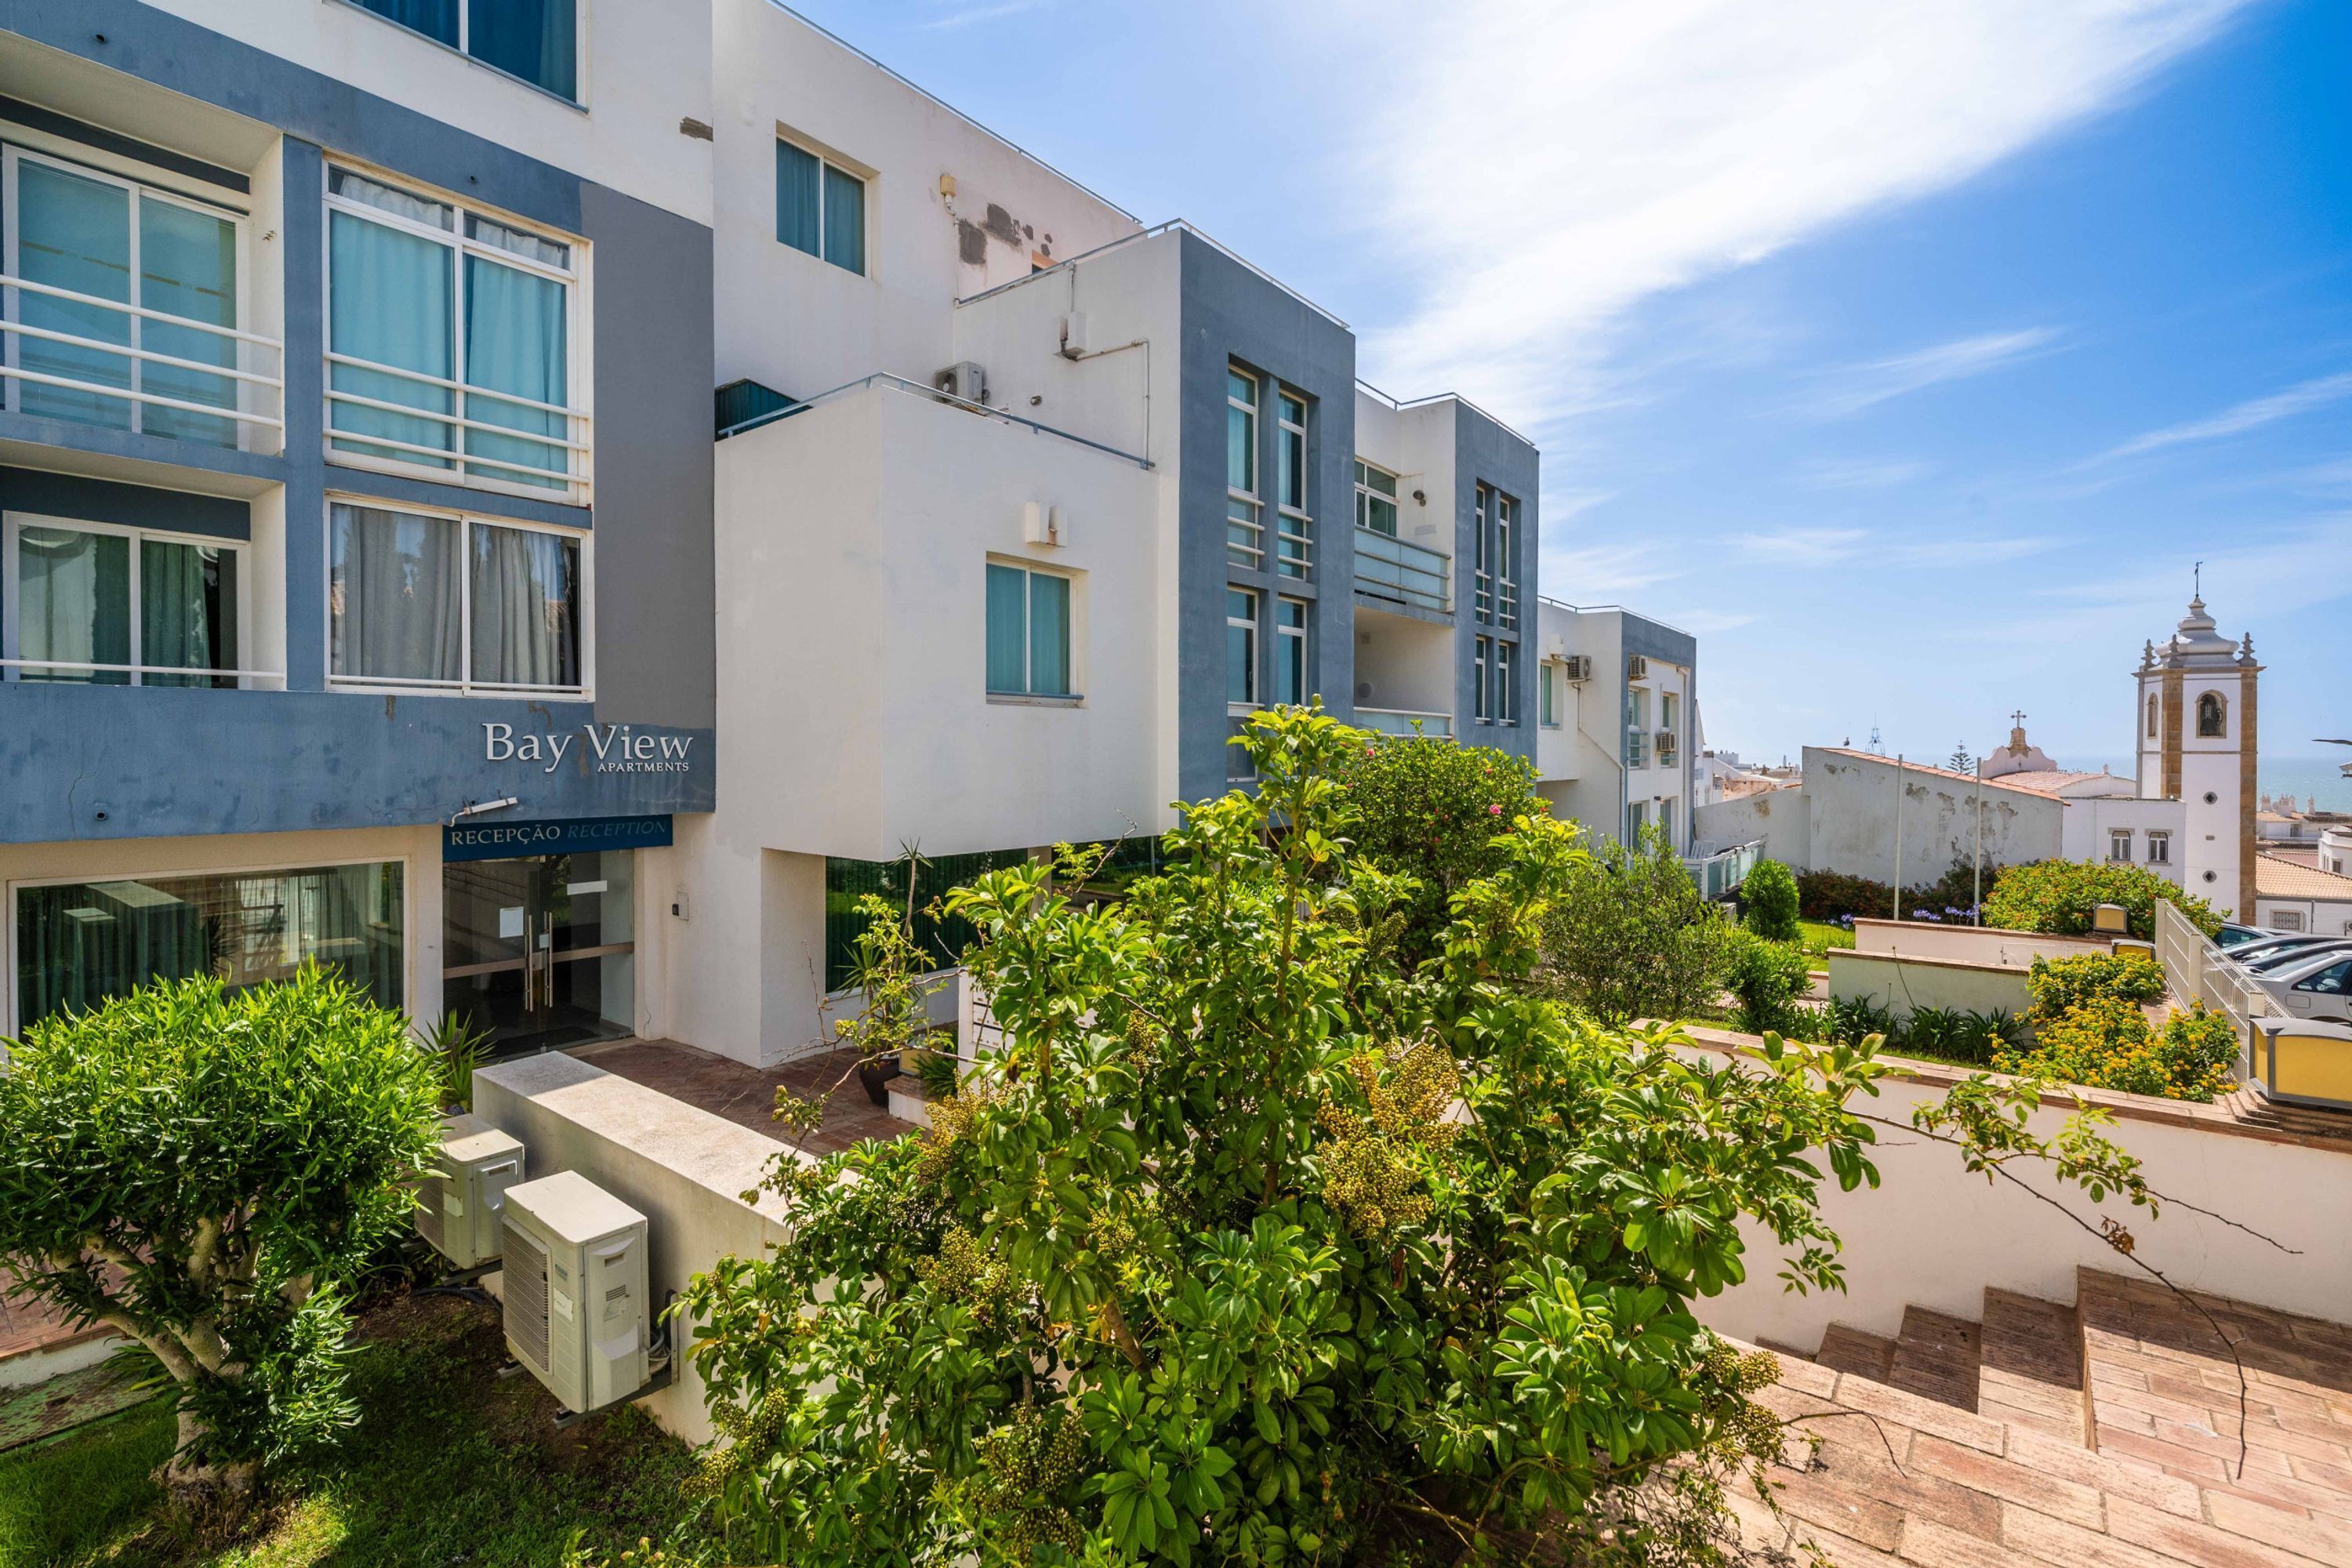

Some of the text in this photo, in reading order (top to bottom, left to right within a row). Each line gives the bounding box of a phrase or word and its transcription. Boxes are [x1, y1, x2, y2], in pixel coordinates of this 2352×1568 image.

[481, 723, 693, 773] Bay View
[597, 762, 689, 772] APARTMENTS
[452, 821, 666, 845] RECEPÇÃO RECEPTION
